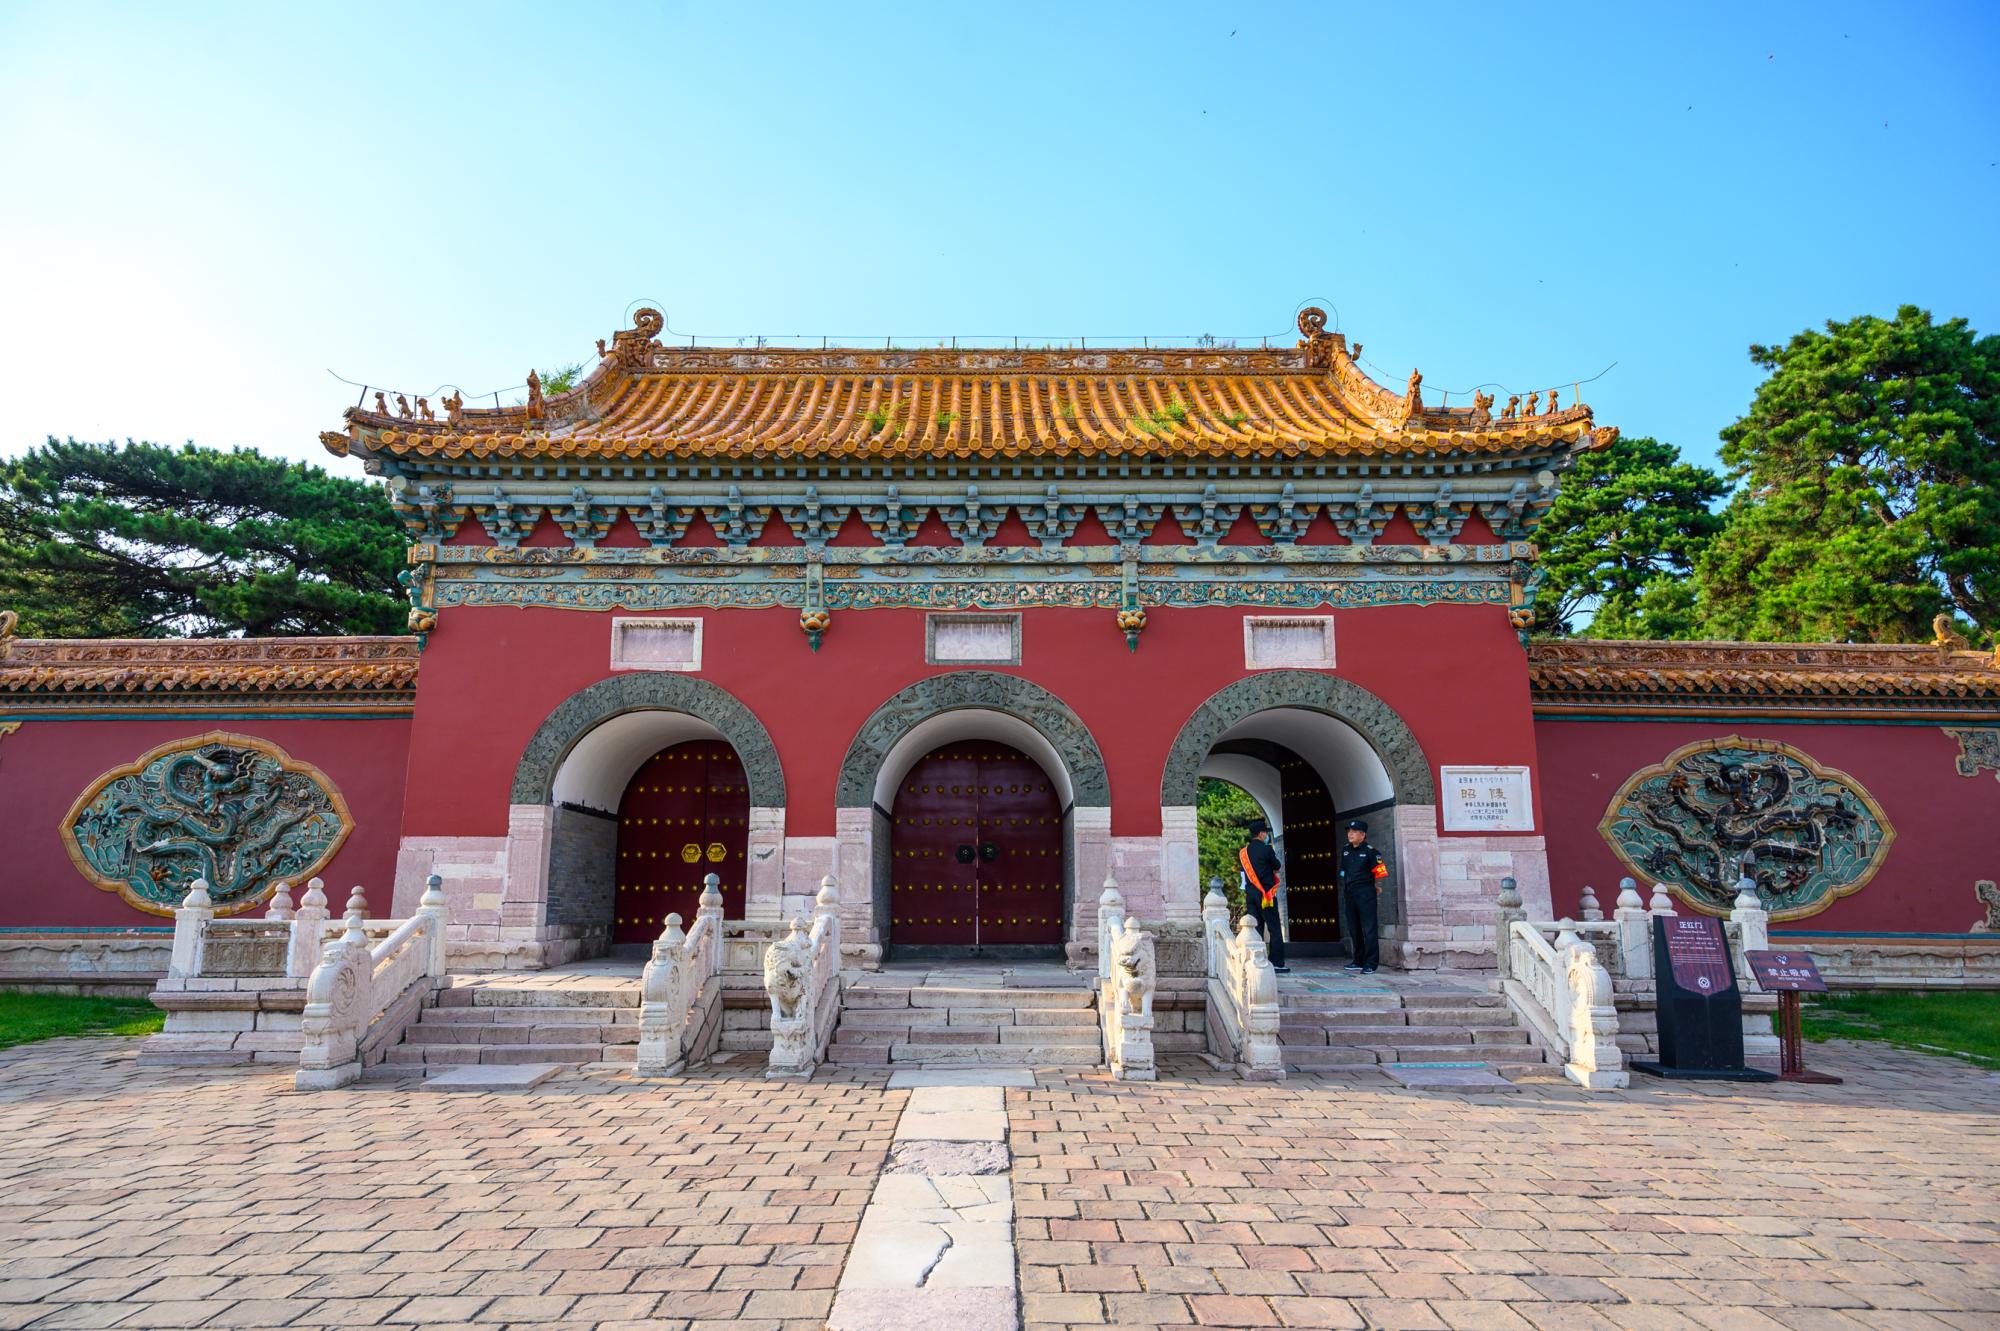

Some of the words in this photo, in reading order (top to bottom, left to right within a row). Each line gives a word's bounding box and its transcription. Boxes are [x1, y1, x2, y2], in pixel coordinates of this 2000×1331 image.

[1680, 921, 1703, 929] 正红门
[1768, 968, 1811, 977] 禁止吸烟
